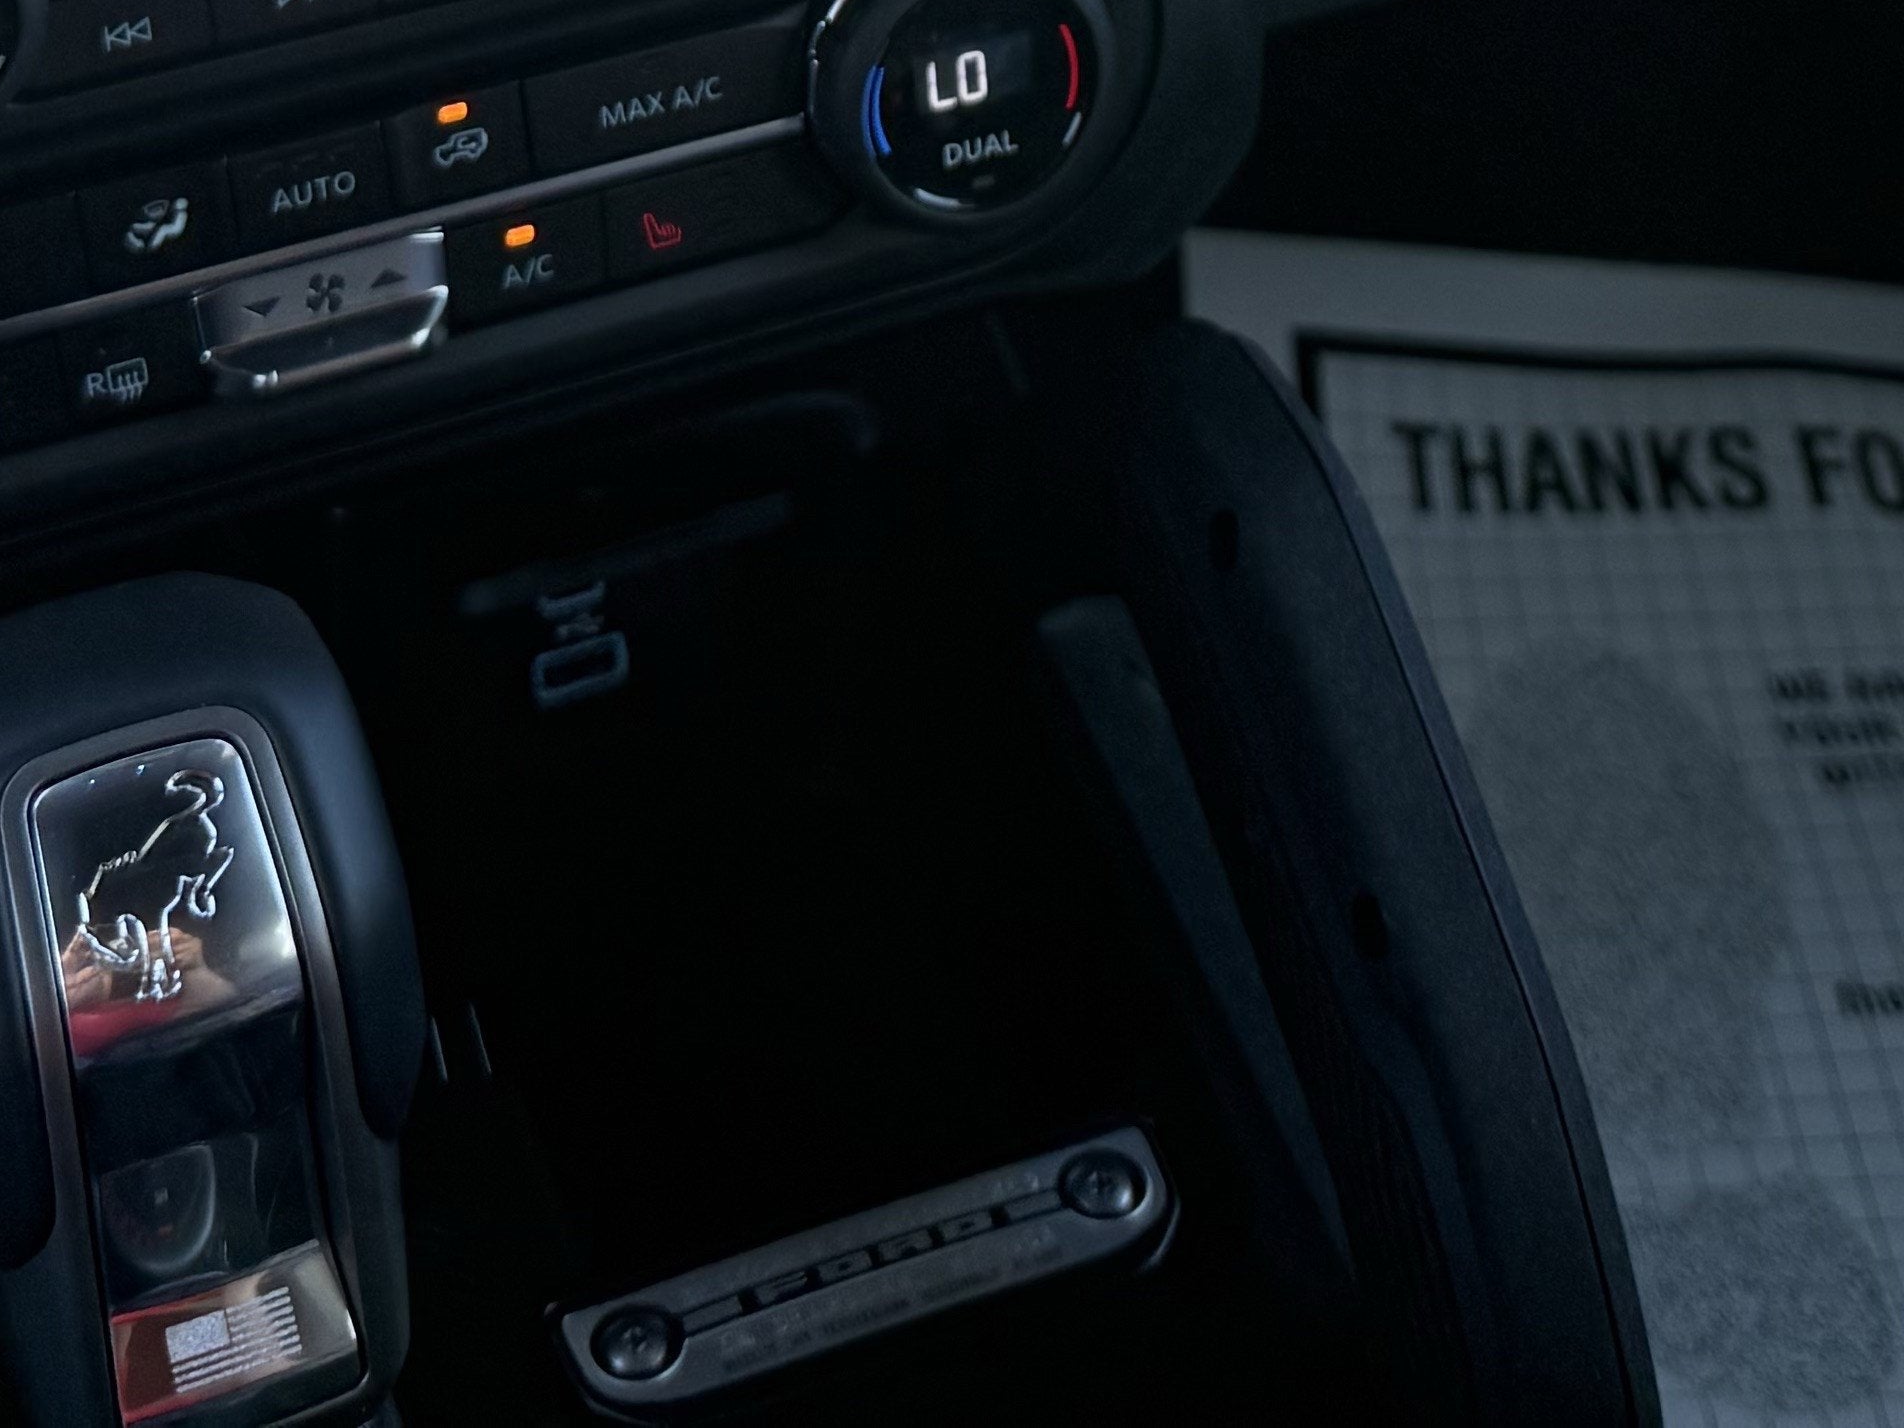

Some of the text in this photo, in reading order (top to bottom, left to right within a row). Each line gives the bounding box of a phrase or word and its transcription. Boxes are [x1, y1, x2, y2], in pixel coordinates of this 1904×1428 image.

[601, 77, 721, 127] MAX A/C
[927, 51, 987, 110] LO
[944, 131, 1017, 167] DUAL
[272, 172, 355, 212] AUTO
[503, 254, 553, 288] A/C
[1392, 420, 1772, 519] THANKS
